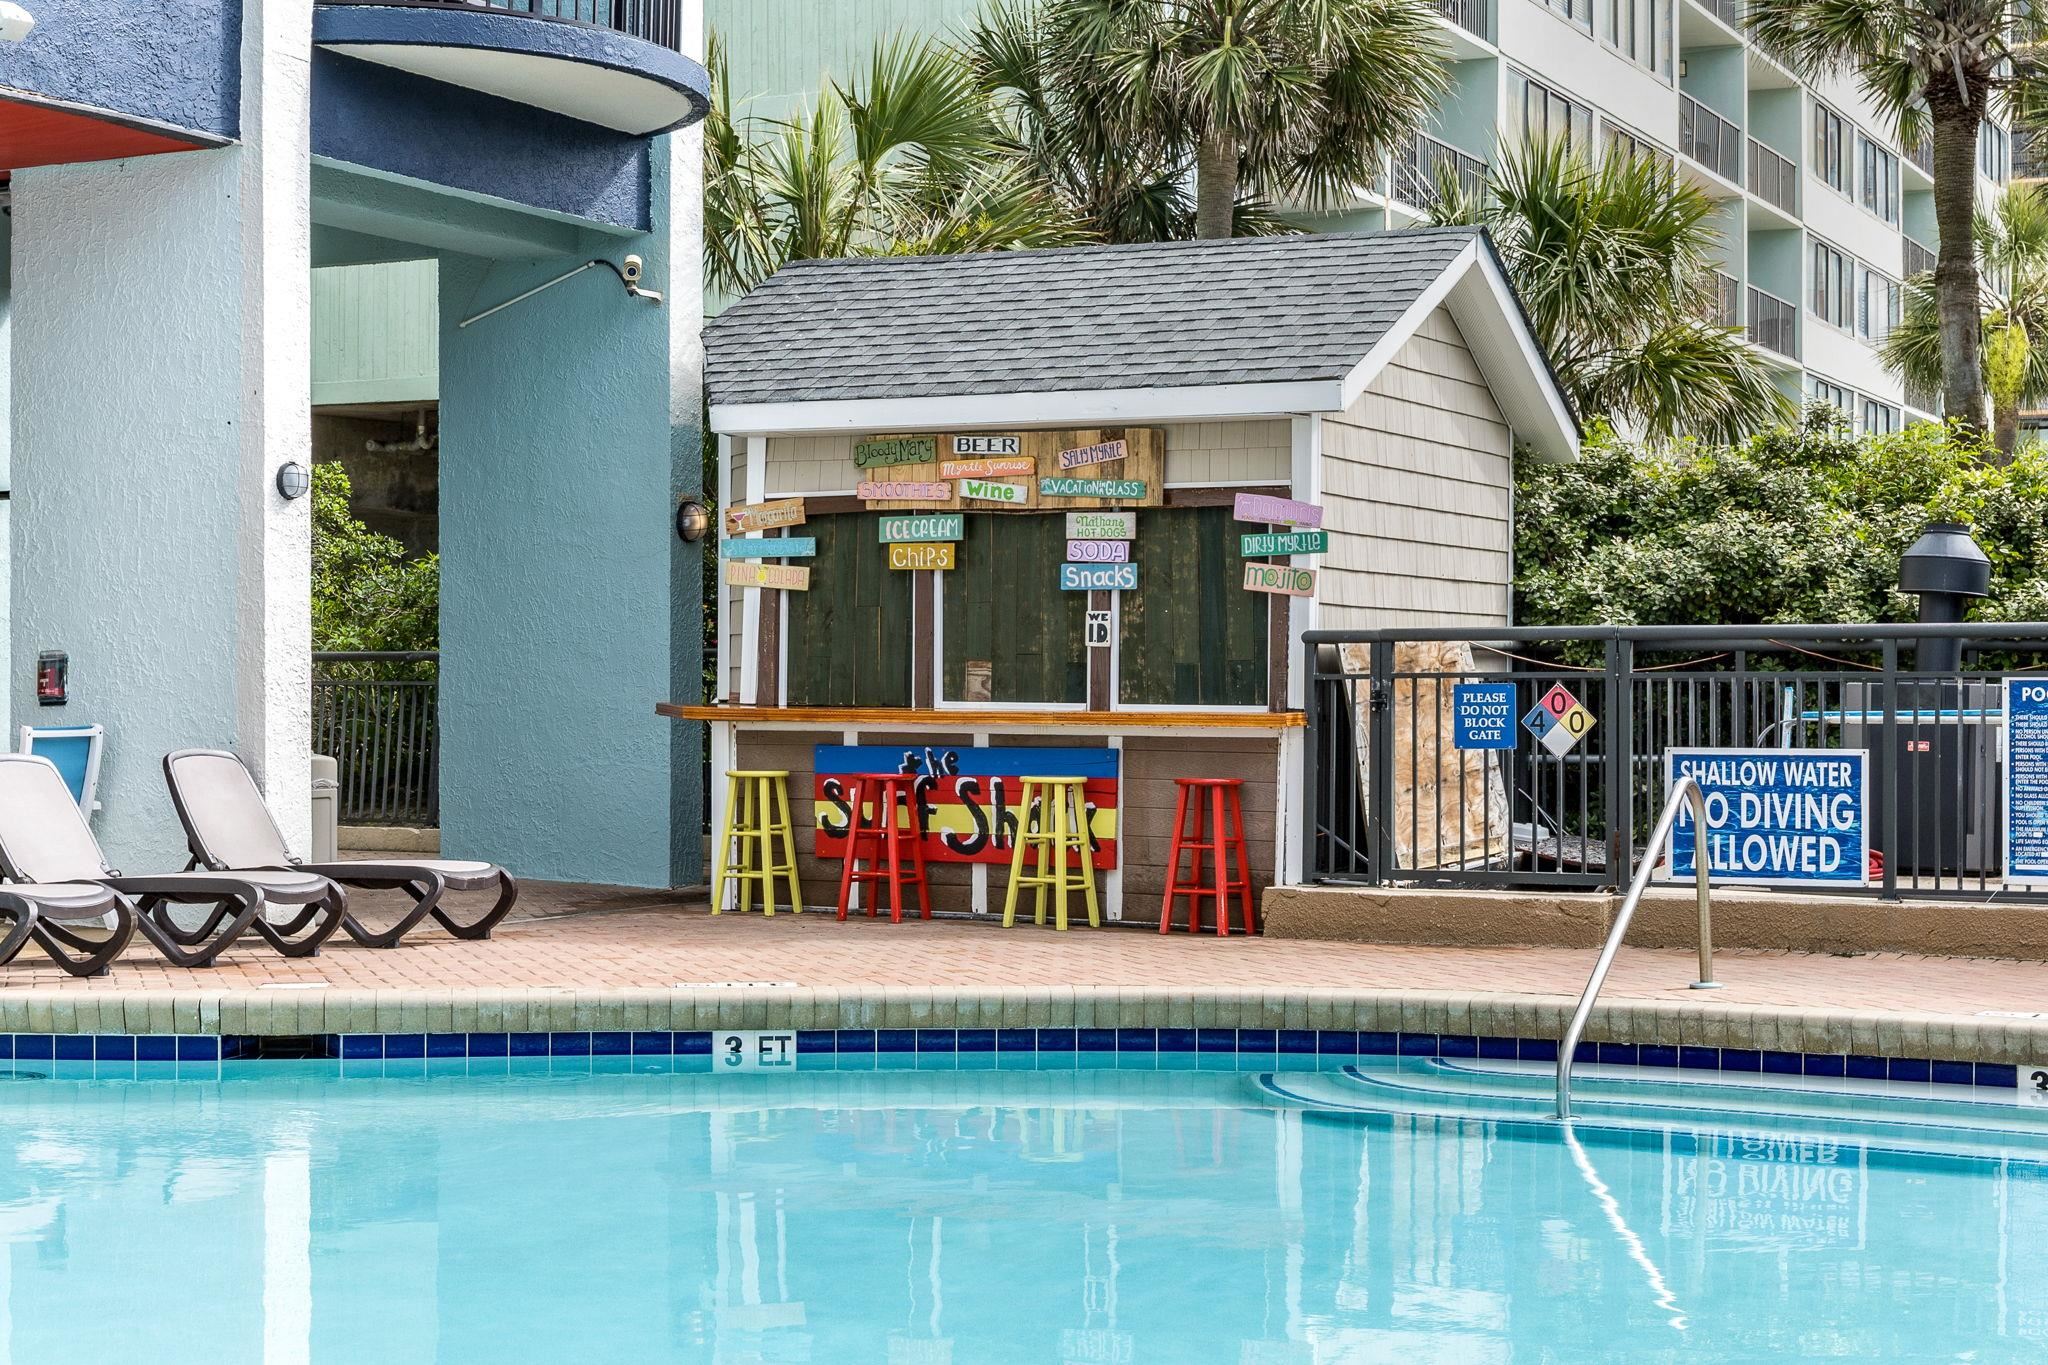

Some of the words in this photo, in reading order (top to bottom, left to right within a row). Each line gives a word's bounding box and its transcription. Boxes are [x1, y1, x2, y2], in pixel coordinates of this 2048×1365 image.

[854, 441, 898, 468] Bloody
[899, 439, 934, 463] Mary
[957, 437, 1016, 453] BEER
[943, 461, 982, 476] Myrtle
[984, 460, 1030, 476] Sunrise
[862, 483, 944, 498] SMOOTHIES
[966, 480, 1014, 500] Wine
[886, 518, 910, 539] ICE
[912, 518, 958, 538] CREAM
[1077, 528, 1097, 537] HOT
[1101, 528, 1126, 537] DOGS
[1070, 541, 1127, 561] SODA
[768, 567, 805, 585] COLADA
[1088, 613, 1108, 621] WE
[1463, 693, 1507, 703] PLEASE
[1551, 692, 1566, 714] 0
[2022, 686, 2048, 702] PO
[1461, 705, 1480, 716] DO
[1482, 705, 1509, 716] NOT
[1464, 717, 1506, 728] BLOCK
[1530, 710, 1546, 733] 4
[1569, 711, 1585, 733] 0
[1469, 730, 1502, 740] GATE
[899, 747, 959, 779] the
[1680, 760, 1777, 786] SHALLOW
[1783, 761, 1852, 787] WATER
[940, 776, 1102, 856] Shak
[1741, 792, 1855, 831] DIVING
[1690, 834, 1841, 872] LLOWED
[725, 1036, 743, 1061] 3
